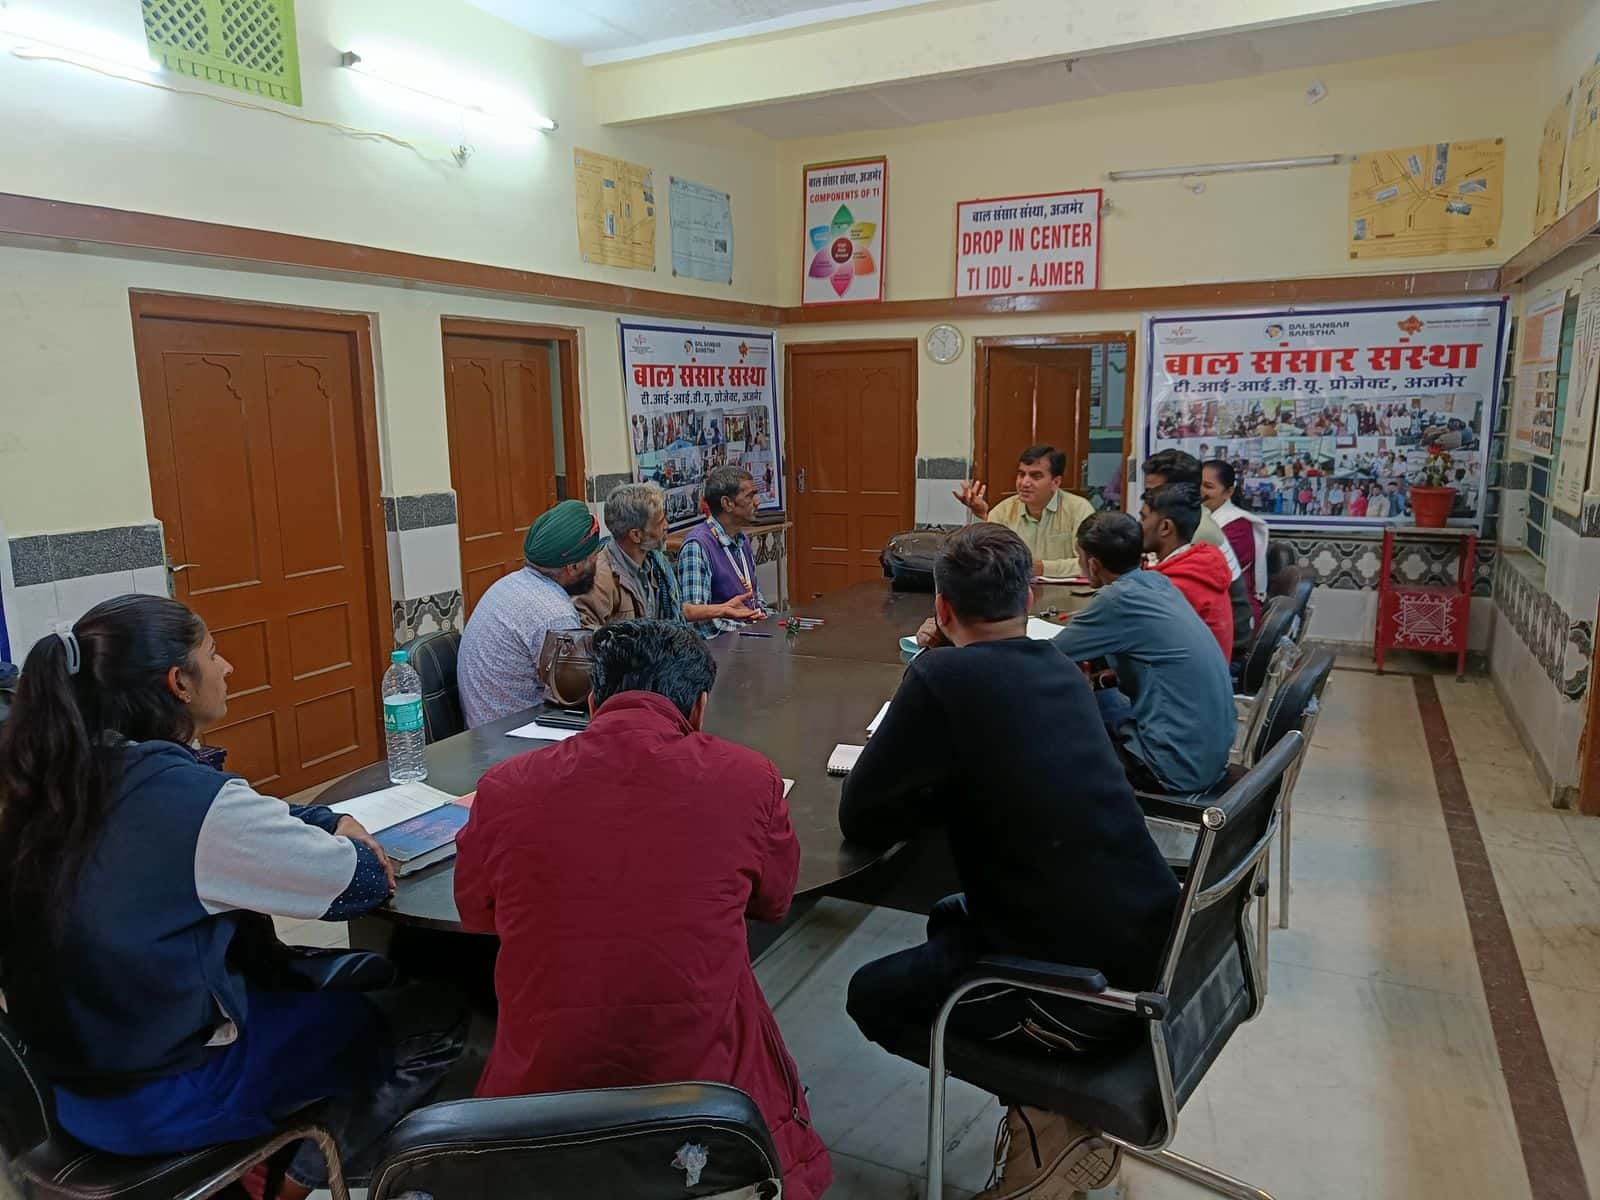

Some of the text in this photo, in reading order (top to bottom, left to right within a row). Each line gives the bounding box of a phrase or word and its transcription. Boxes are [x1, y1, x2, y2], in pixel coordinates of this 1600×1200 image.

[810, 188, 880, 204] COMPONENTS OF TI
[972, 210, 992, 223] बाल
[993, 204, 1018, 220] संसार
[1050, 198, 1085, 216] अजमेर
[962, 222, 1092, 256] DROP IN CENTER
[967, 266, 980, 290] TI
[986, 265, 1012, 290] IDU
[1030, 260, 1085, 287] AJMER
[1288, 321, 1350, 330] BAL SANSAR
[1288, 328, 1336, 338] SANSTHA
[1163, 337, 1484, 376] बाल संसार संस्था
[632, 356, 767, 388] बाल संसार संस्था
[1330, 375, 1398, 392] प्रोजेक्ट,
[1404, 373, 1467, 390] अजमेर
